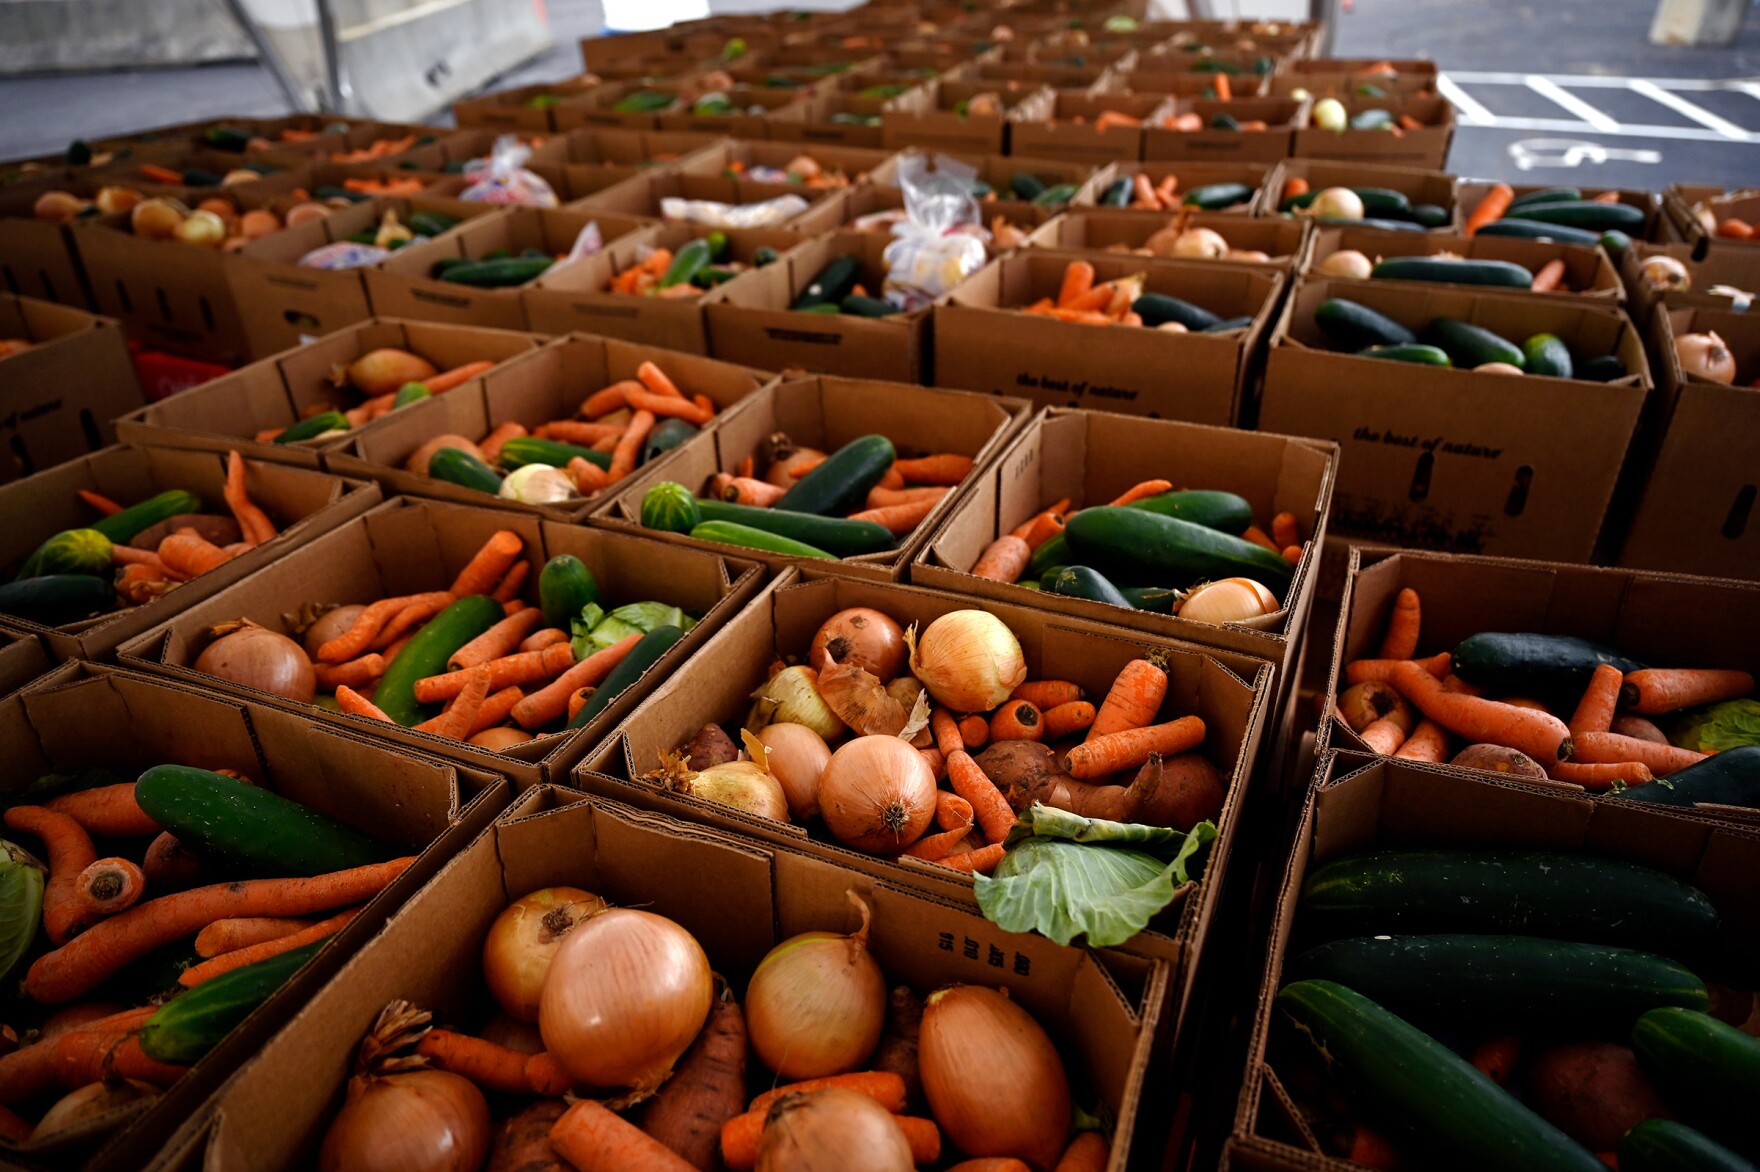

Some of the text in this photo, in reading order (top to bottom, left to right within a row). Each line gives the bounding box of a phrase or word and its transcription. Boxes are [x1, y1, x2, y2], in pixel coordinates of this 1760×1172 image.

[1016, 371, 1138, 400] the best of nature
[1353, 425, 1502, 458] the best of nature
